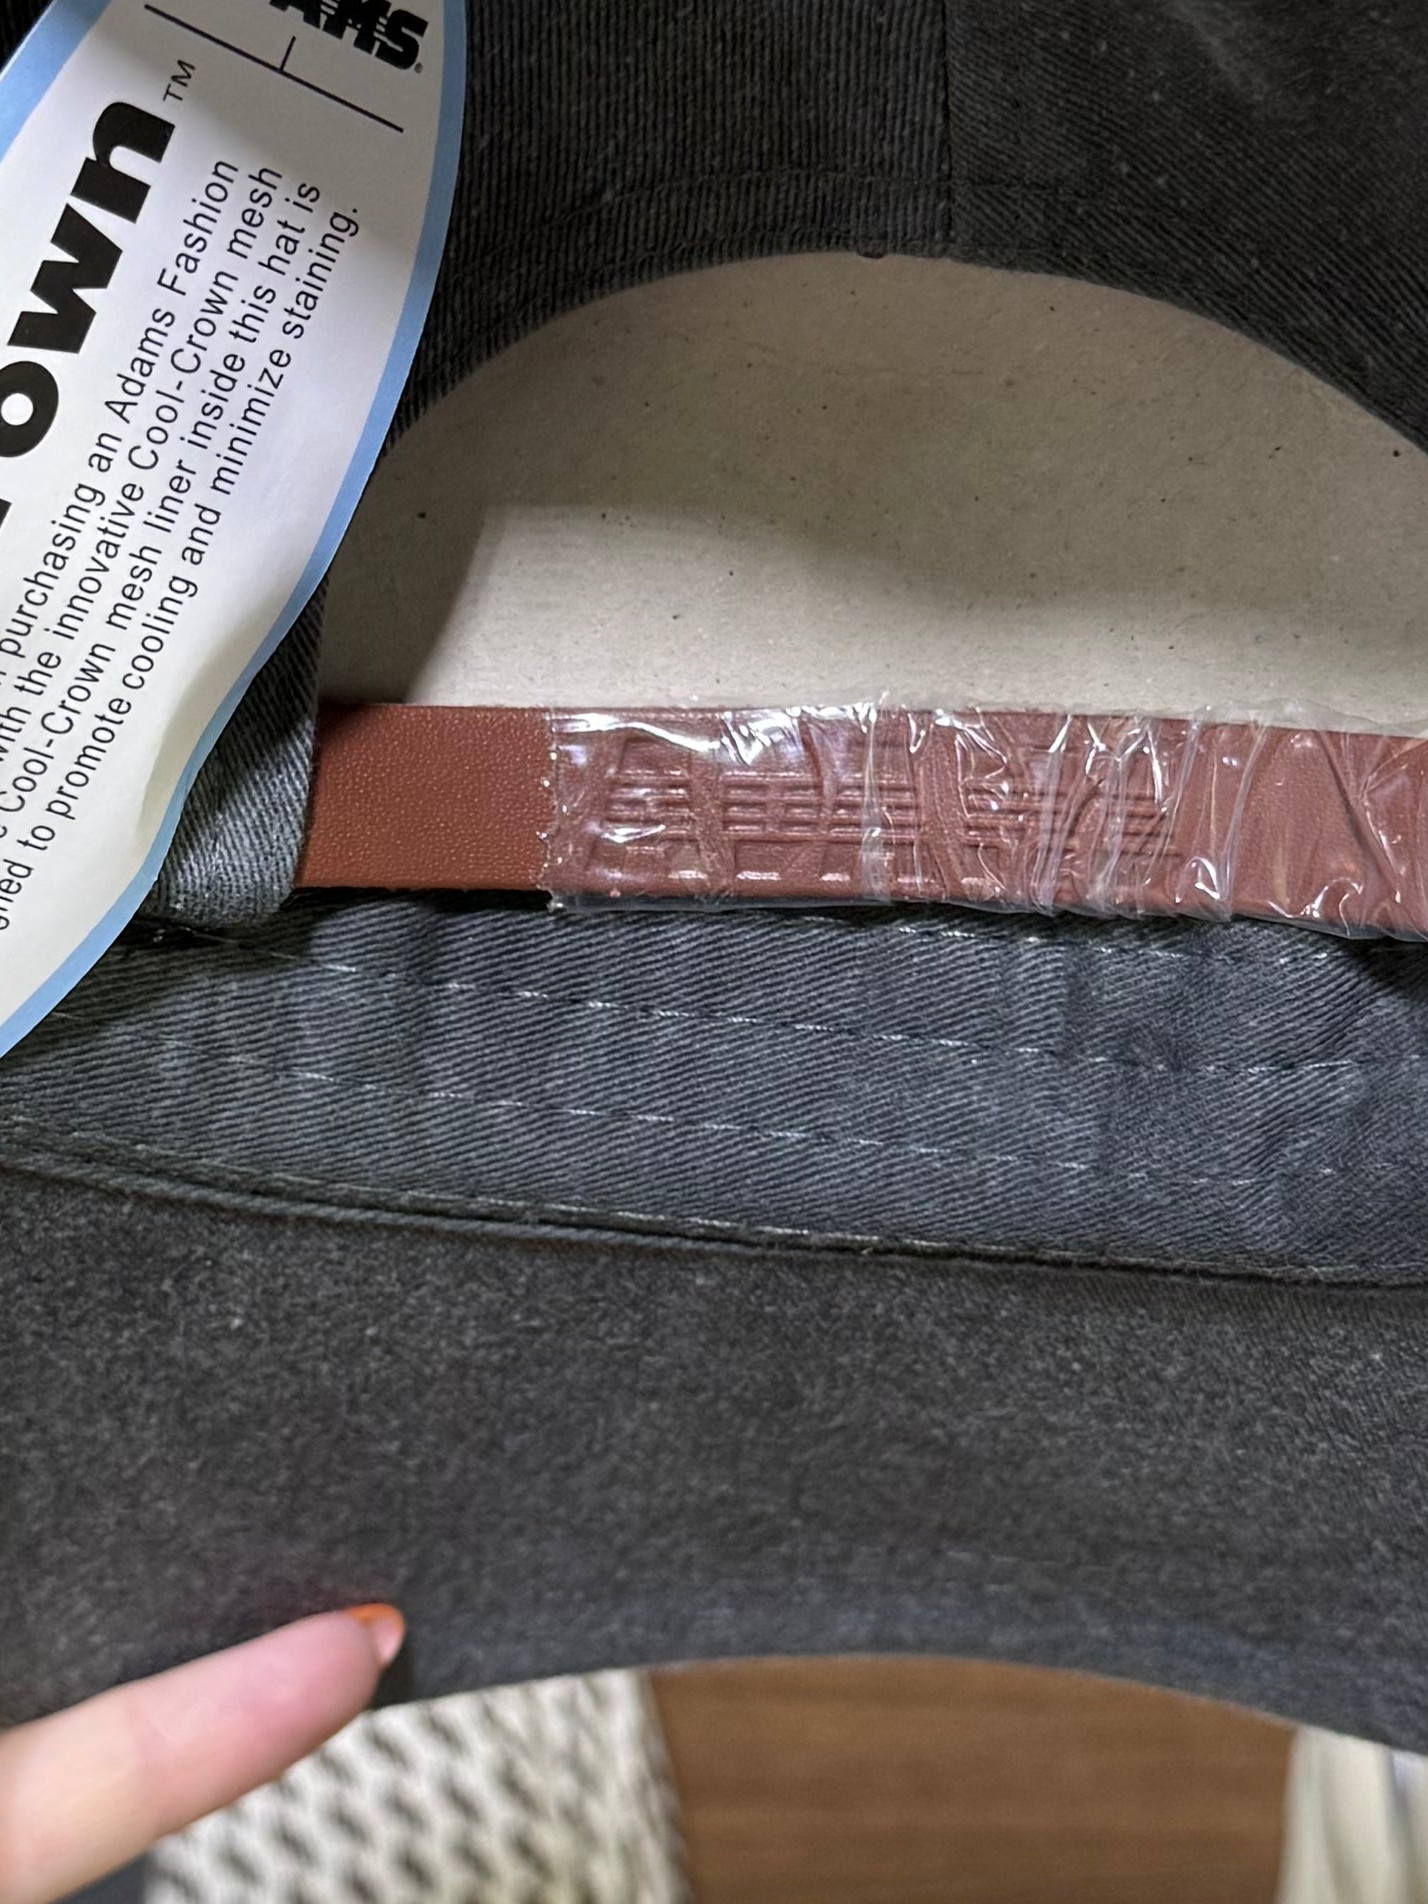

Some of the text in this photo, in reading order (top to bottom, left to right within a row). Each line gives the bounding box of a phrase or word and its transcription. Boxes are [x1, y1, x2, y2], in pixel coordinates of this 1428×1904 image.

[103, 307, 176, 424] Adams
[156, 159, 239, 296] Fashion
[12, 650, 62, 696] the
[43, 481, 144, 640] innovative
[126, 269, 239, 470] Cool-Crown
[225, 166, 283, 260] mesh
[15, 824, 56, 851] to
[44, 697, 132, 820] promote
[121, 574, 199, 690] cooling
[180, 502, 222, 566] and
[208, 348, 292, 496] minimize
[281, 207, 360, 340] staining.
[87, 431, 122, 473] an
[104, 544, 162, 630] mesh
[141, 458, 197, 533] liner
[178, 352, 246, 450] inside
[227, 284, 277, 343] this
[256, 218, 306, 276] hat
[283, 181, 321, 213] is
